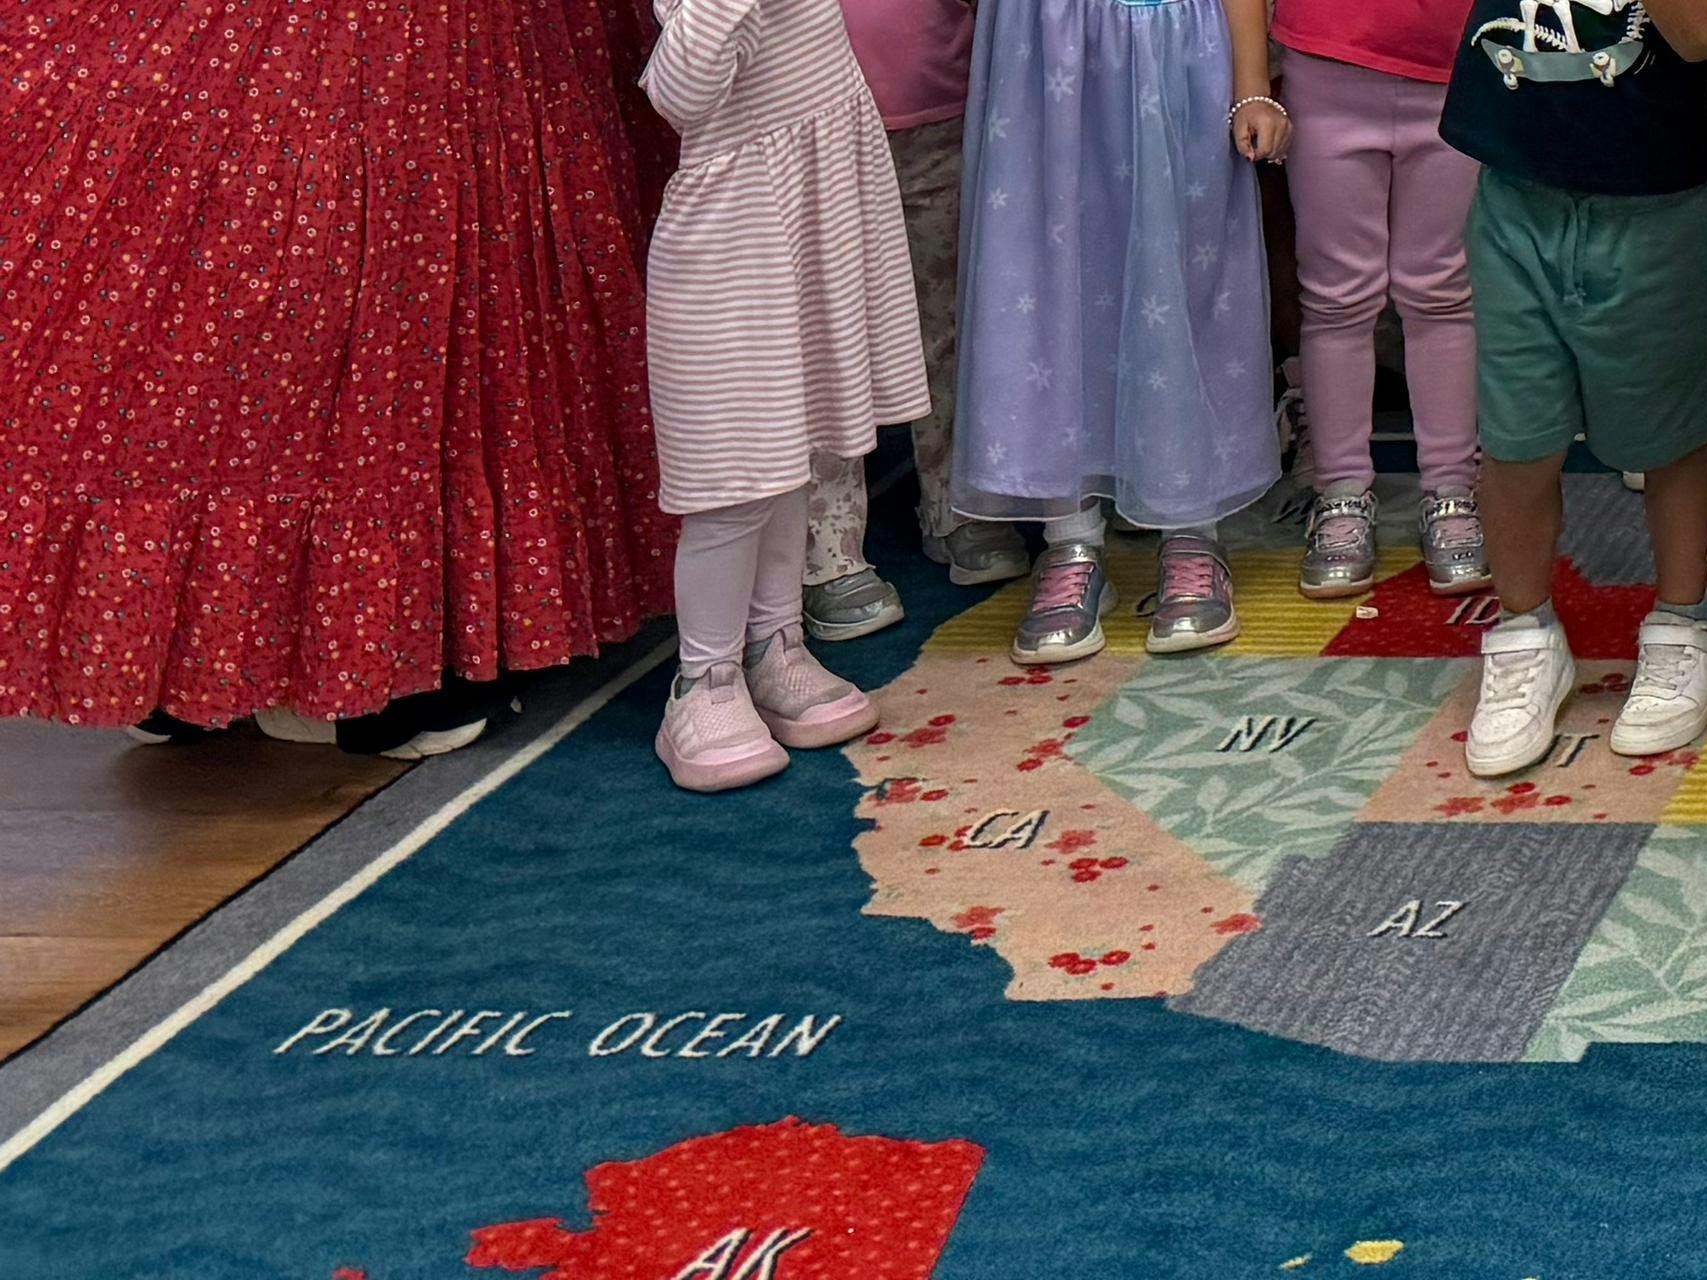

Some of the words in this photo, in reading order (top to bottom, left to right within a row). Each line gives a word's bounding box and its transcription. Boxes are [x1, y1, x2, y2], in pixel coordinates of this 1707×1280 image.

[1215, 713, 1319, 753] NV
[963, 807, 1051, 849] CA
[1366, 899, 1468, 940] AZ
[273, 1007, 573, 1056] PACIFIC
[587, 1011, 843, 1059] OCEAN
[670, 1226, 816, 1280] AK
